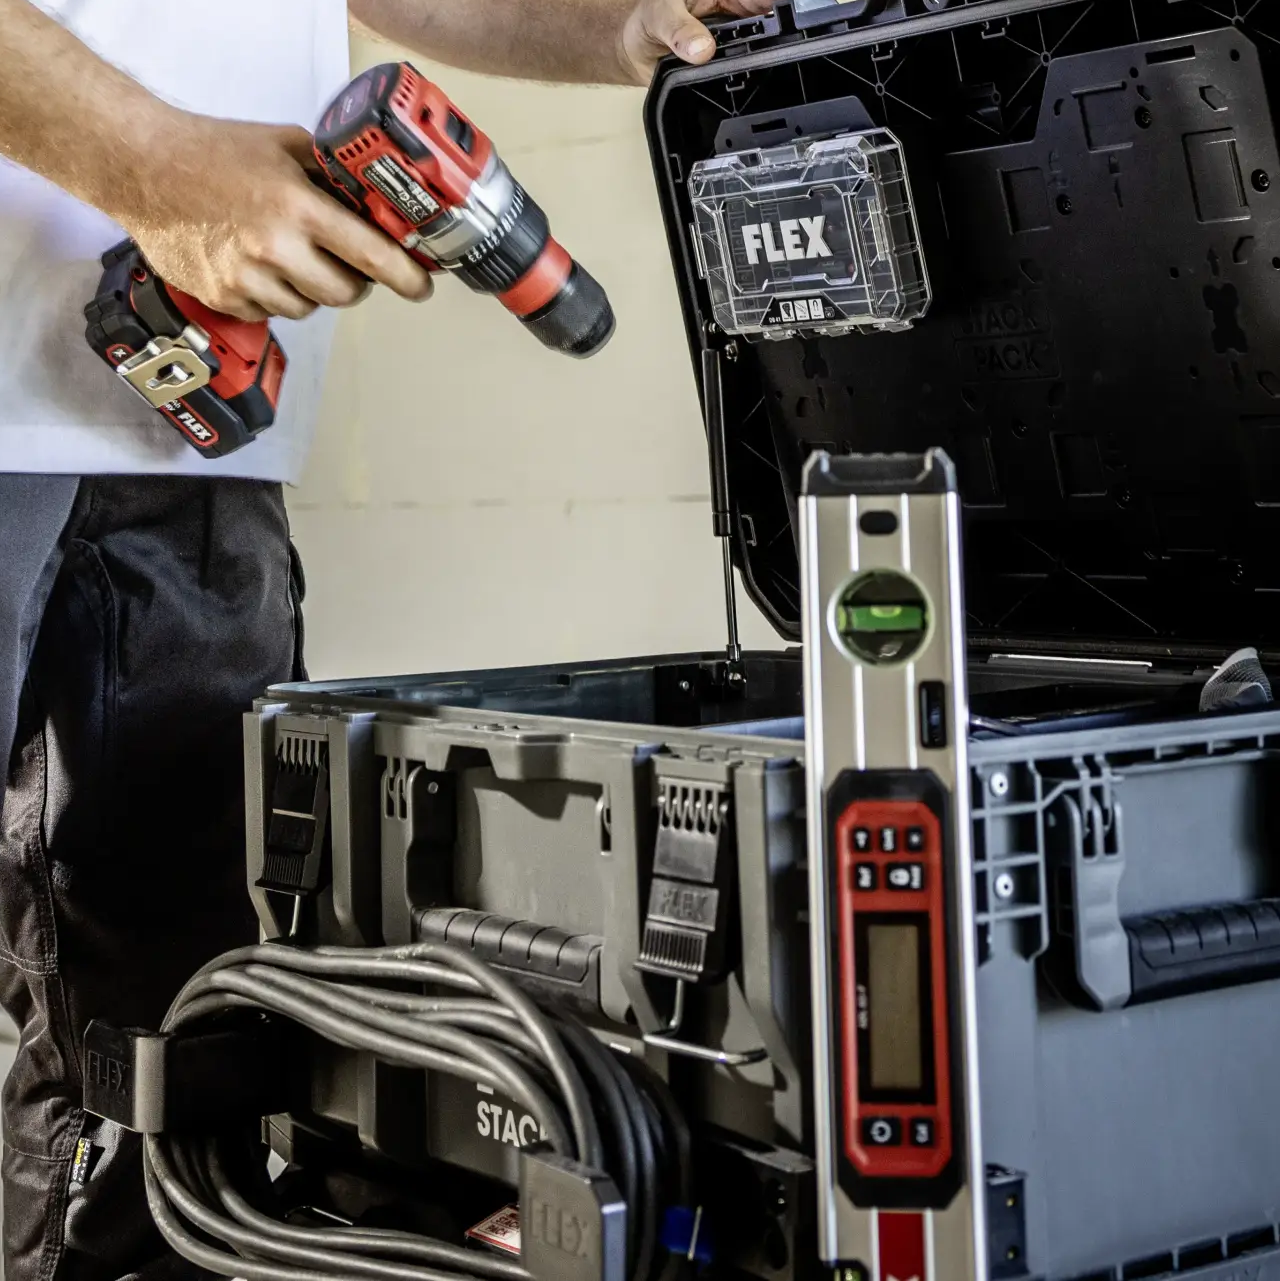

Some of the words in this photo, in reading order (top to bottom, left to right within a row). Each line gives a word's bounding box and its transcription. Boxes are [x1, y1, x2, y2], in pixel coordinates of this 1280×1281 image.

[410, 181, 440, 214] FLEX
[741, 215, 834, 265] FLEX
[177, 411, 212, 441] FLEX
[87, 1050, 131, 1096] FLEX
[477, 1100, 549, 1148] STAC
[529, 1198, 589, 1258] FLEX
